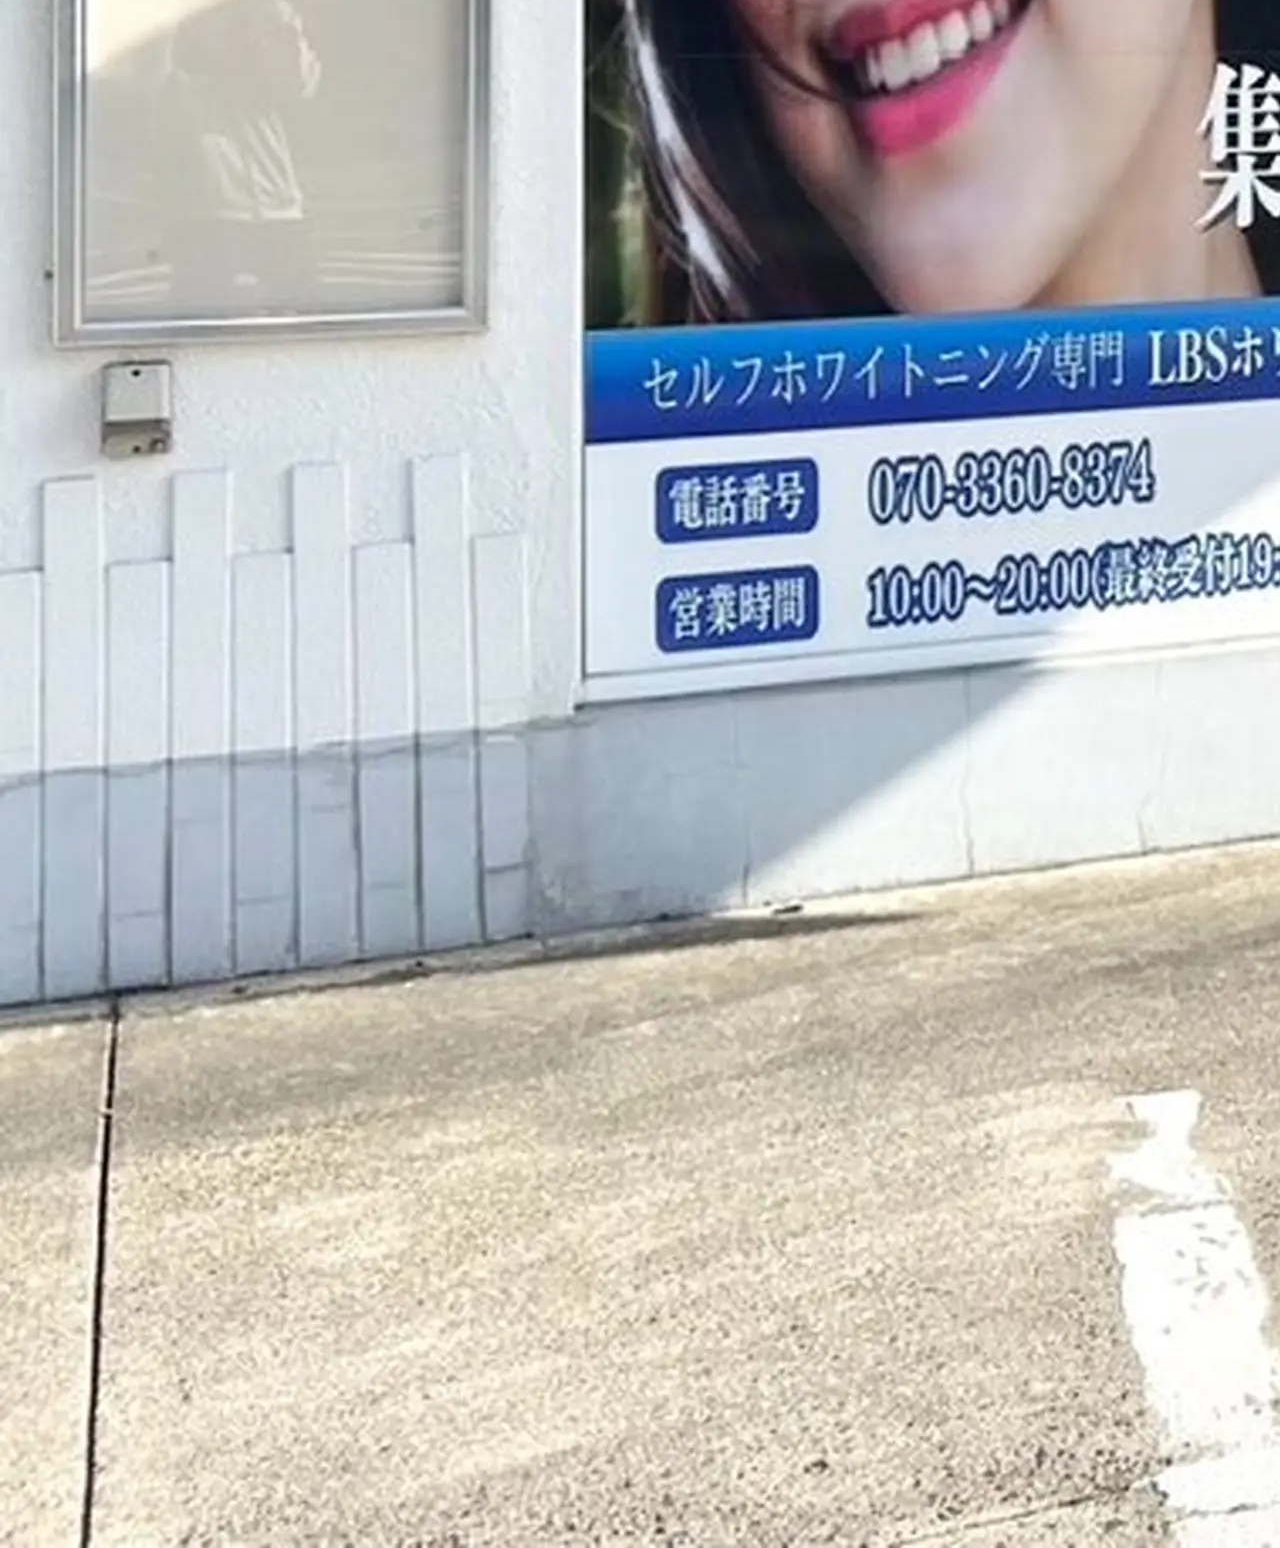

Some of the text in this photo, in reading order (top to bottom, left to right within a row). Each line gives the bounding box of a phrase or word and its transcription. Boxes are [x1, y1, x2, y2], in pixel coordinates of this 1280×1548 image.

[643, 331, 1125, 409] セルフホワイトニング専門
[669, 471, 805, 529] 電話番号
[868, 437, 1155, 525] 070-3360-8374
[669, 578, 807, 640] 営業時間
